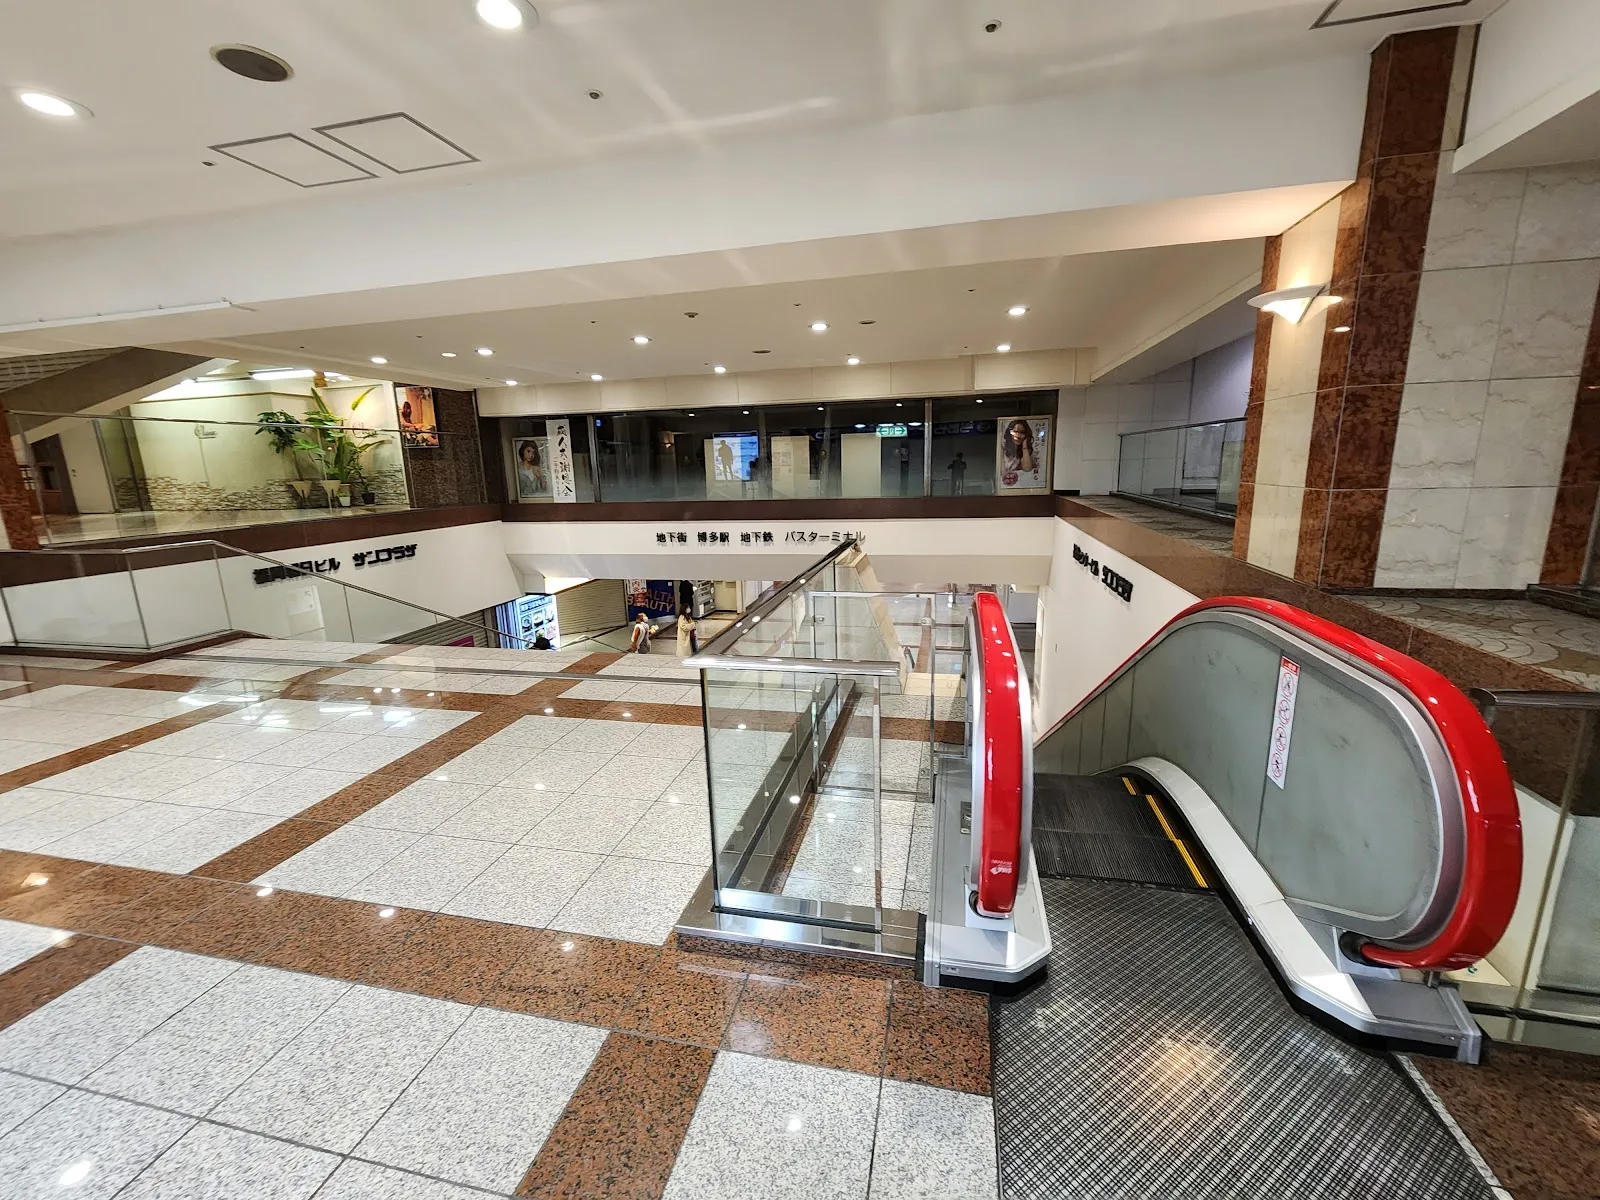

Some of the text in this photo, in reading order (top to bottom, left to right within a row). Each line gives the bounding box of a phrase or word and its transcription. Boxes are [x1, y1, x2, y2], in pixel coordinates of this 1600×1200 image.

[656, 530, 866, 543] 地下街 博多駅 地下鉄 バスターミナル
